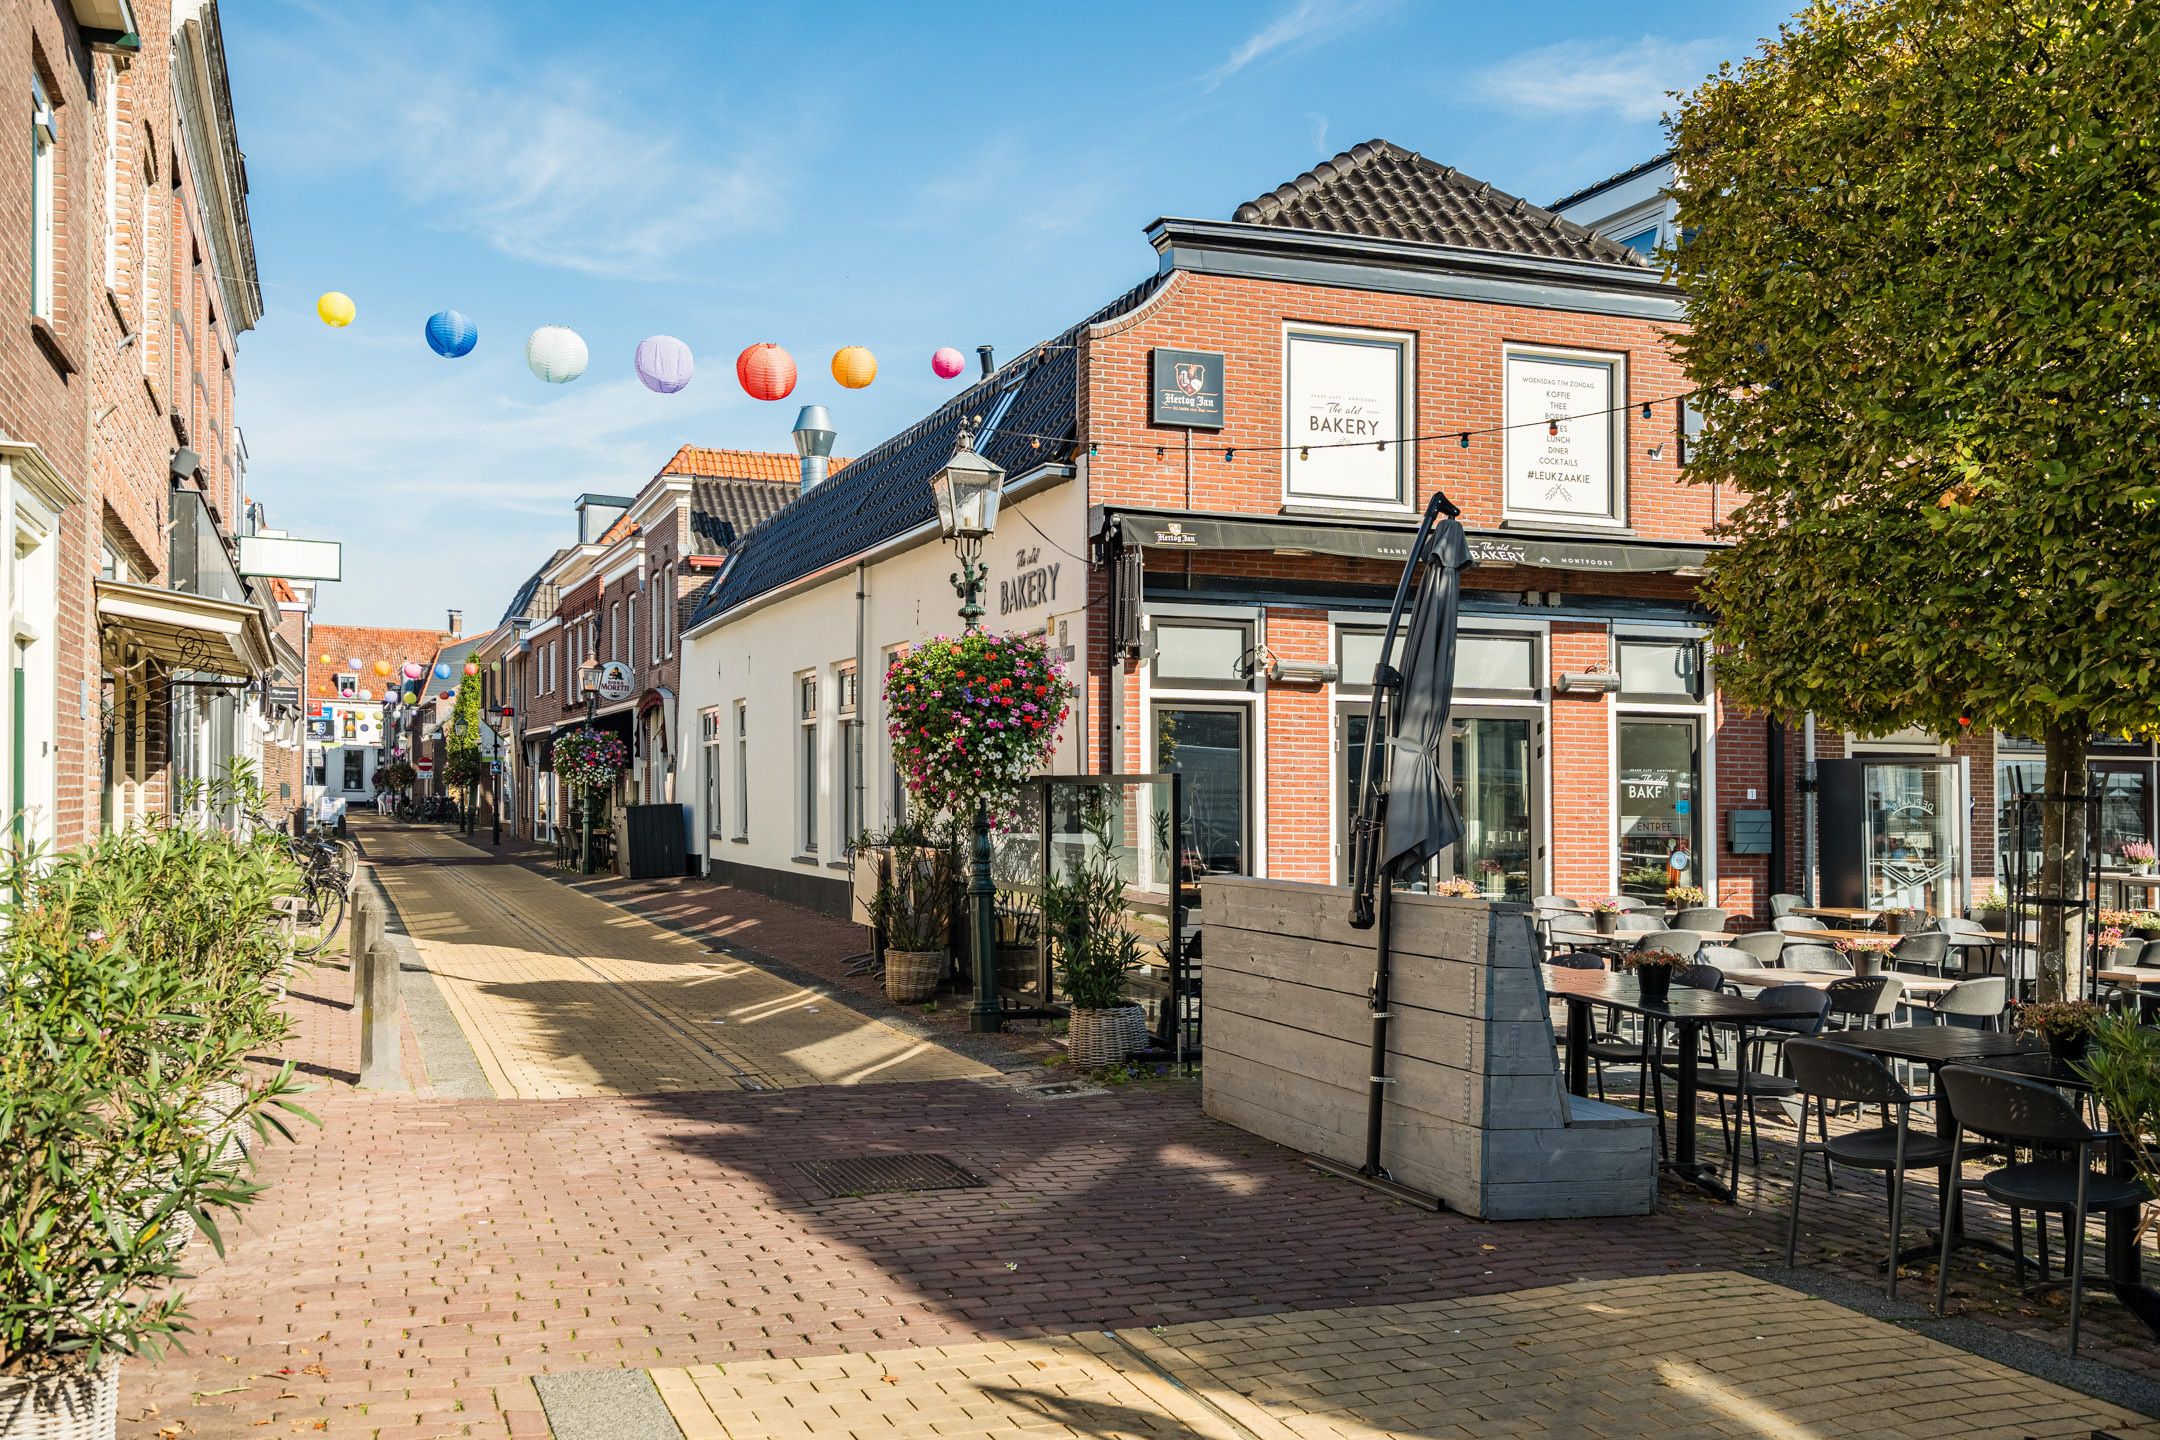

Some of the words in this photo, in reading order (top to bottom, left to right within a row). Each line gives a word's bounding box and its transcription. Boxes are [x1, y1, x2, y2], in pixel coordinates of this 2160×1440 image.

[1522, 377, 1556, 386] WOENSDAG
[1569, 380, 1595, 389] ZONDAG
[1162, 393, 1195, 407] Hertog
[1546, 390, 1571, 400] KOFFIE
[1326, 402, 1343, 414] The
[1345, 405, 1362, 415] old
[1550, 401, 1567, 410] THEE
[1309, 415, 1379, 436] BAKERY
[1546, 435, 1571, 444] LUNCH
[1548, 446, 1569, 455] DINER
[1538, 456, 1578, 467] COCKTAILS
[1527, 470, 1590, 484] #LEUKZAAKIE
[1377, 547, 1407, 555] GRAND
[1480, 541, 1495, 551] The
[1496, 543, 1510, 552] old
[1016, 549, 1026, 570] The
[1027, 546, 1041, 564] old
[1470, 550, 1526, 562] BAKERY
[1561, 557, 1613, 566] MONTFOORT
[1000, 562, 1060, 616] BAKERY
[601, 683, 630, 692] MORETTI
[1637, 822, 1673, 832] ENTREE
